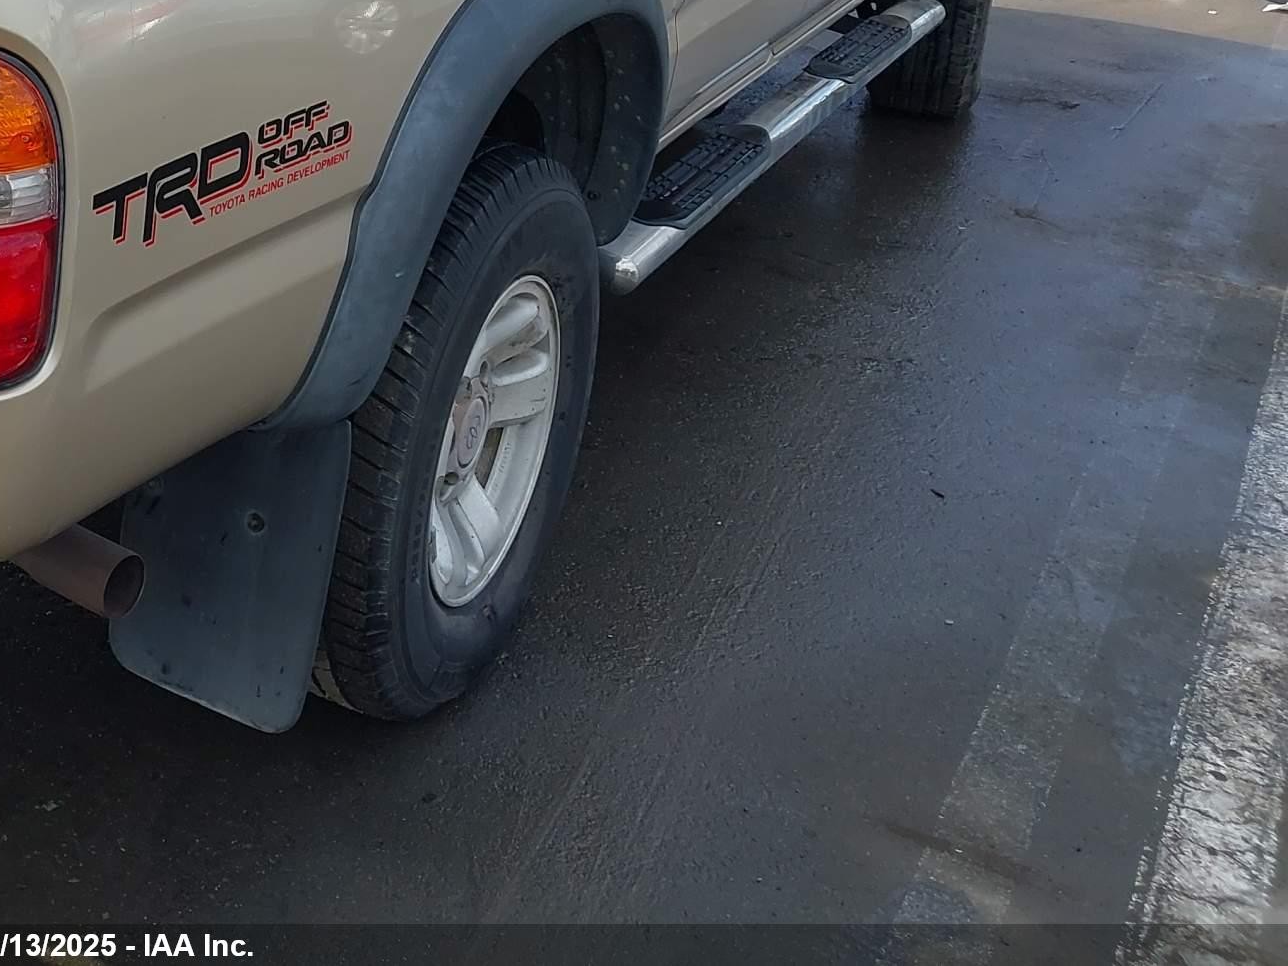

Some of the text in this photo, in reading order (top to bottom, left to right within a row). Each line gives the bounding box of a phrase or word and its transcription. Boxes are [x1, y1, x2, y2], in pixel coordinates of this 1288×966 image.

[255, 121, 352, 179] ROAD
[257, 100, 330, 148] OFF
[92, 131, 253, 247] TRD
[209, 150, 350, 217] TOYOTA RACING DEVELOPMENT
